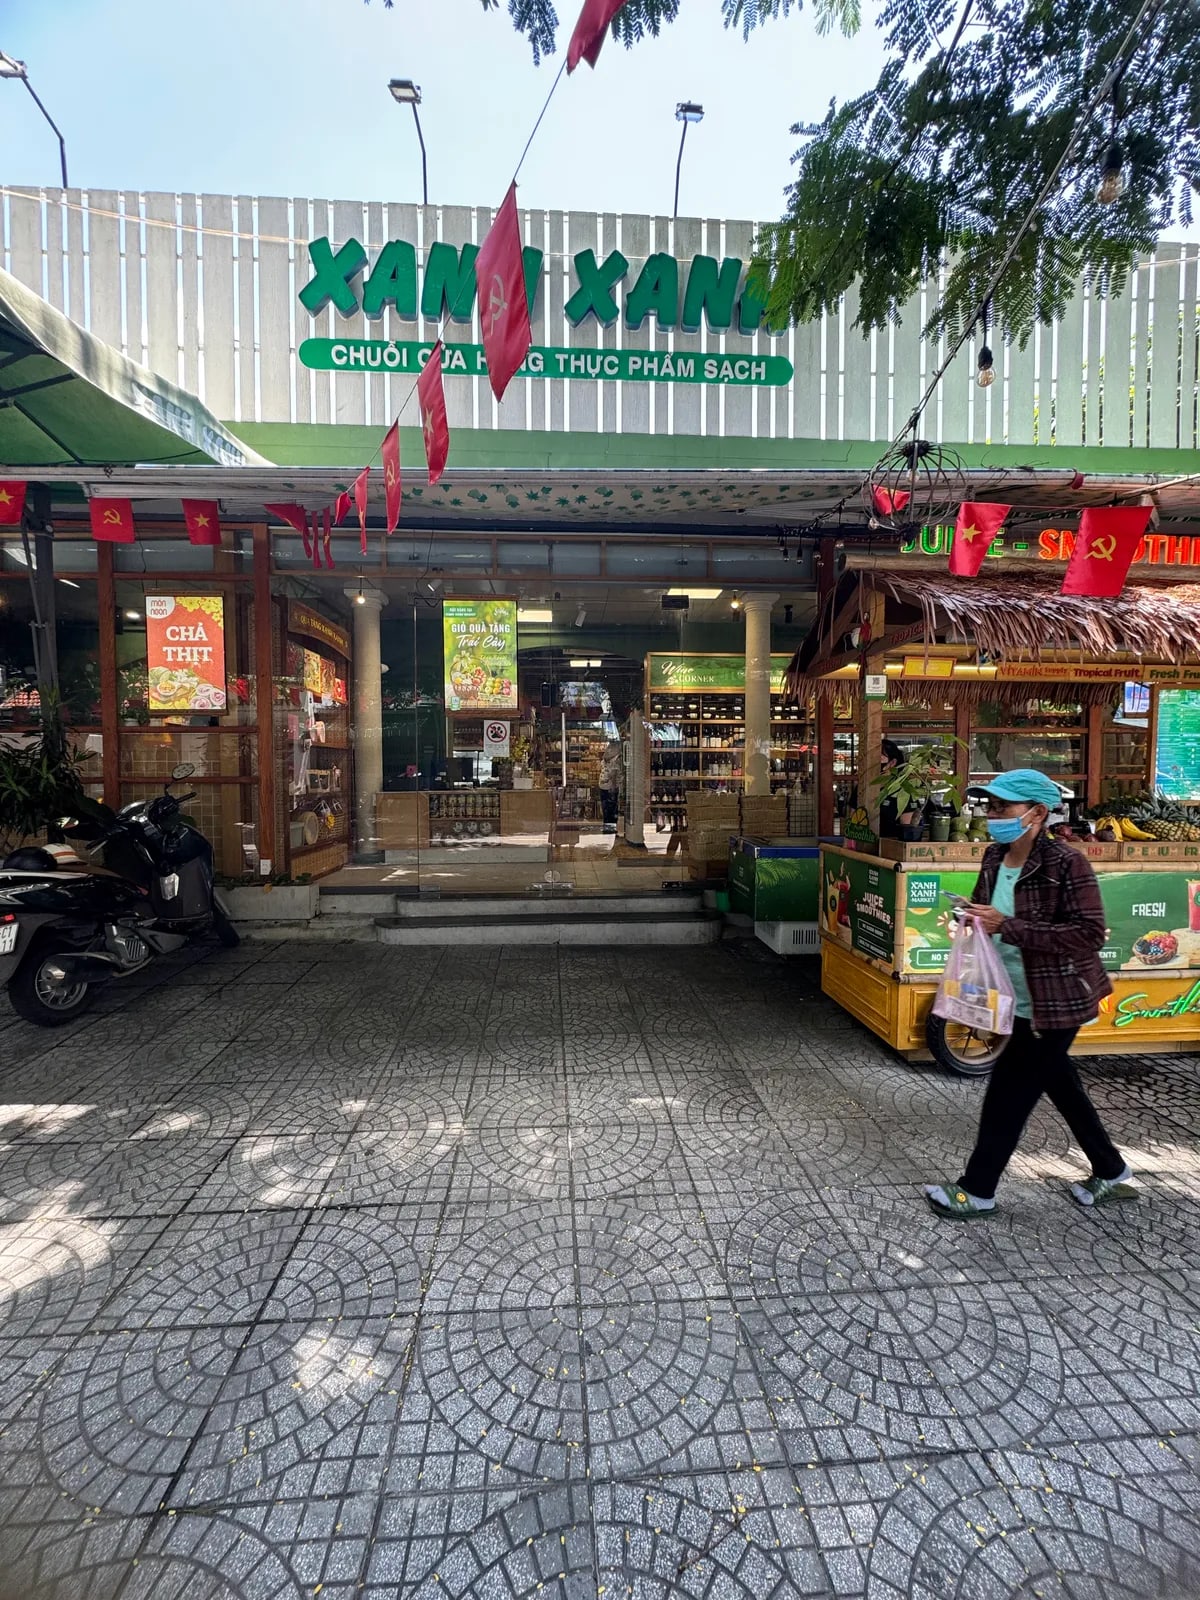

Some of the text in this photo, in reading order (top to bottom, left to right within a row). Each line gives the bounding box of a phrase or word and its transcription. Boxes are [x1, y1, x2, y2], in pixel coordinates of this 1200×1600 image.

[298, 236, 544, 325] XAN
[331, 340, 408, 367] CHUỖI
[555, 353, 620, 378] THỰC
[703, 358, 766, 382] SẠCH
[166, 621, 208, 641] CHẢ
[162, 646, 213, 666] THỊT
[1073, 668, 1113, 679] Tropical
[1150, 669, 1180, 679] Fresh
[910, 881, 937, 890] XANH
[910, 889, 937, 898] XANH
[862, 891, 885, 908] JUICE
[1131, 902, 1167, 918] FRESH
